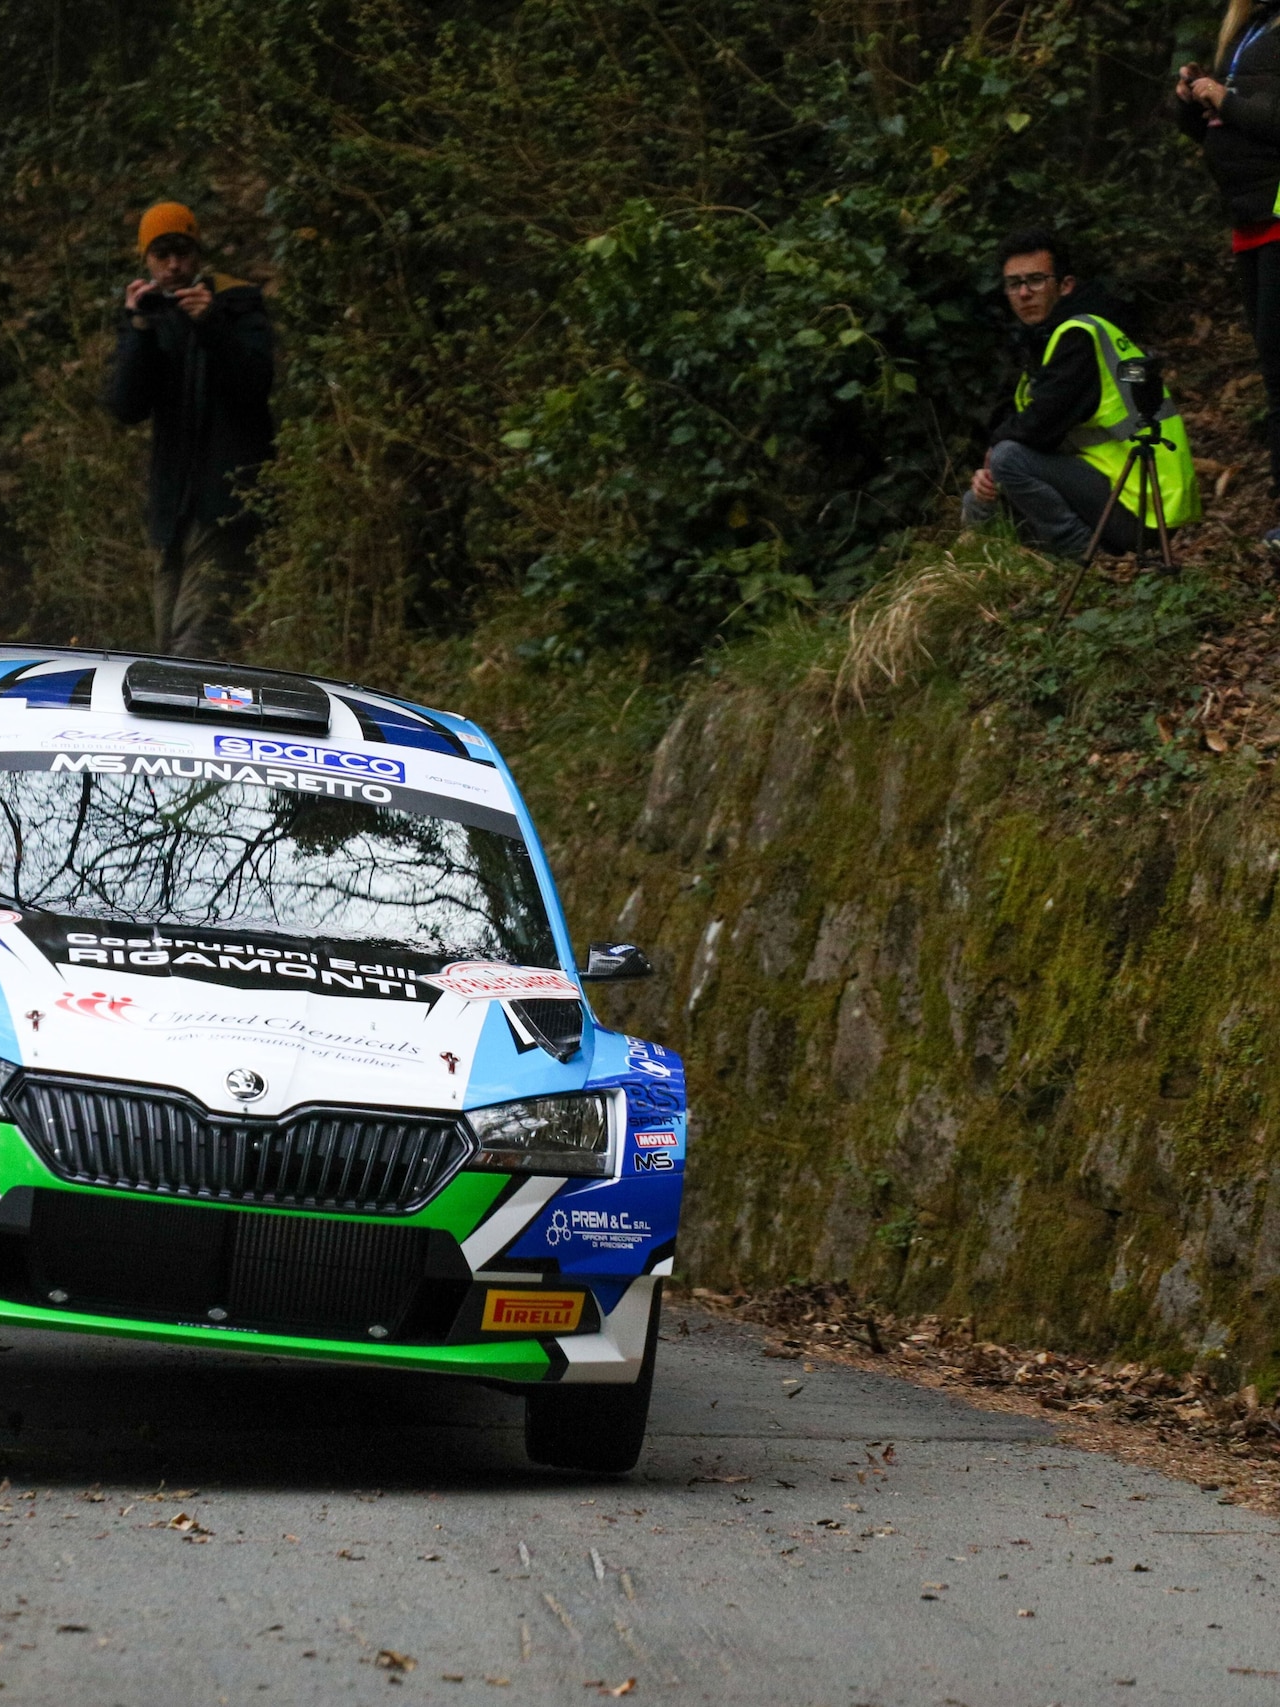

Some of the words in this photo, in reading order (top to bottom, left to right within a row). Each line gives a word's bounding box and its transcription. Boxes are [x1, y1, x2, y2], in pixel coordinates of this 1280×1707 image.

[219, 737, 401, 776] sparco
[50, 753, 127, 773] MS
[131, 757, 392, 804] MUNARETTO
[67, 932, 319, 964] Costruzioni
[328, 957, 416, 981] Edili
[68, 948, 418, 999] RIGAMONTI
[148, 1011, 258, 1025] United
[264, 1018, 421, 1056] Chemicals
[208, 1034, 306, 1051] generation
[312, 1049, 334, 1058] of
[335, 1051, 401, 1069] leather
[622, 1083, 679, 1113] BS
[629, 1115, 682, 1127] SPORT
[639, 1135, 676, 1147] MOTUL
[634, 1152, 674, 1171] MS
[571, 1210, 608, 1229] PREMI
[610, 1215, 620, 1230] &
[492, 1298, 575, 1325] PIRELLI
